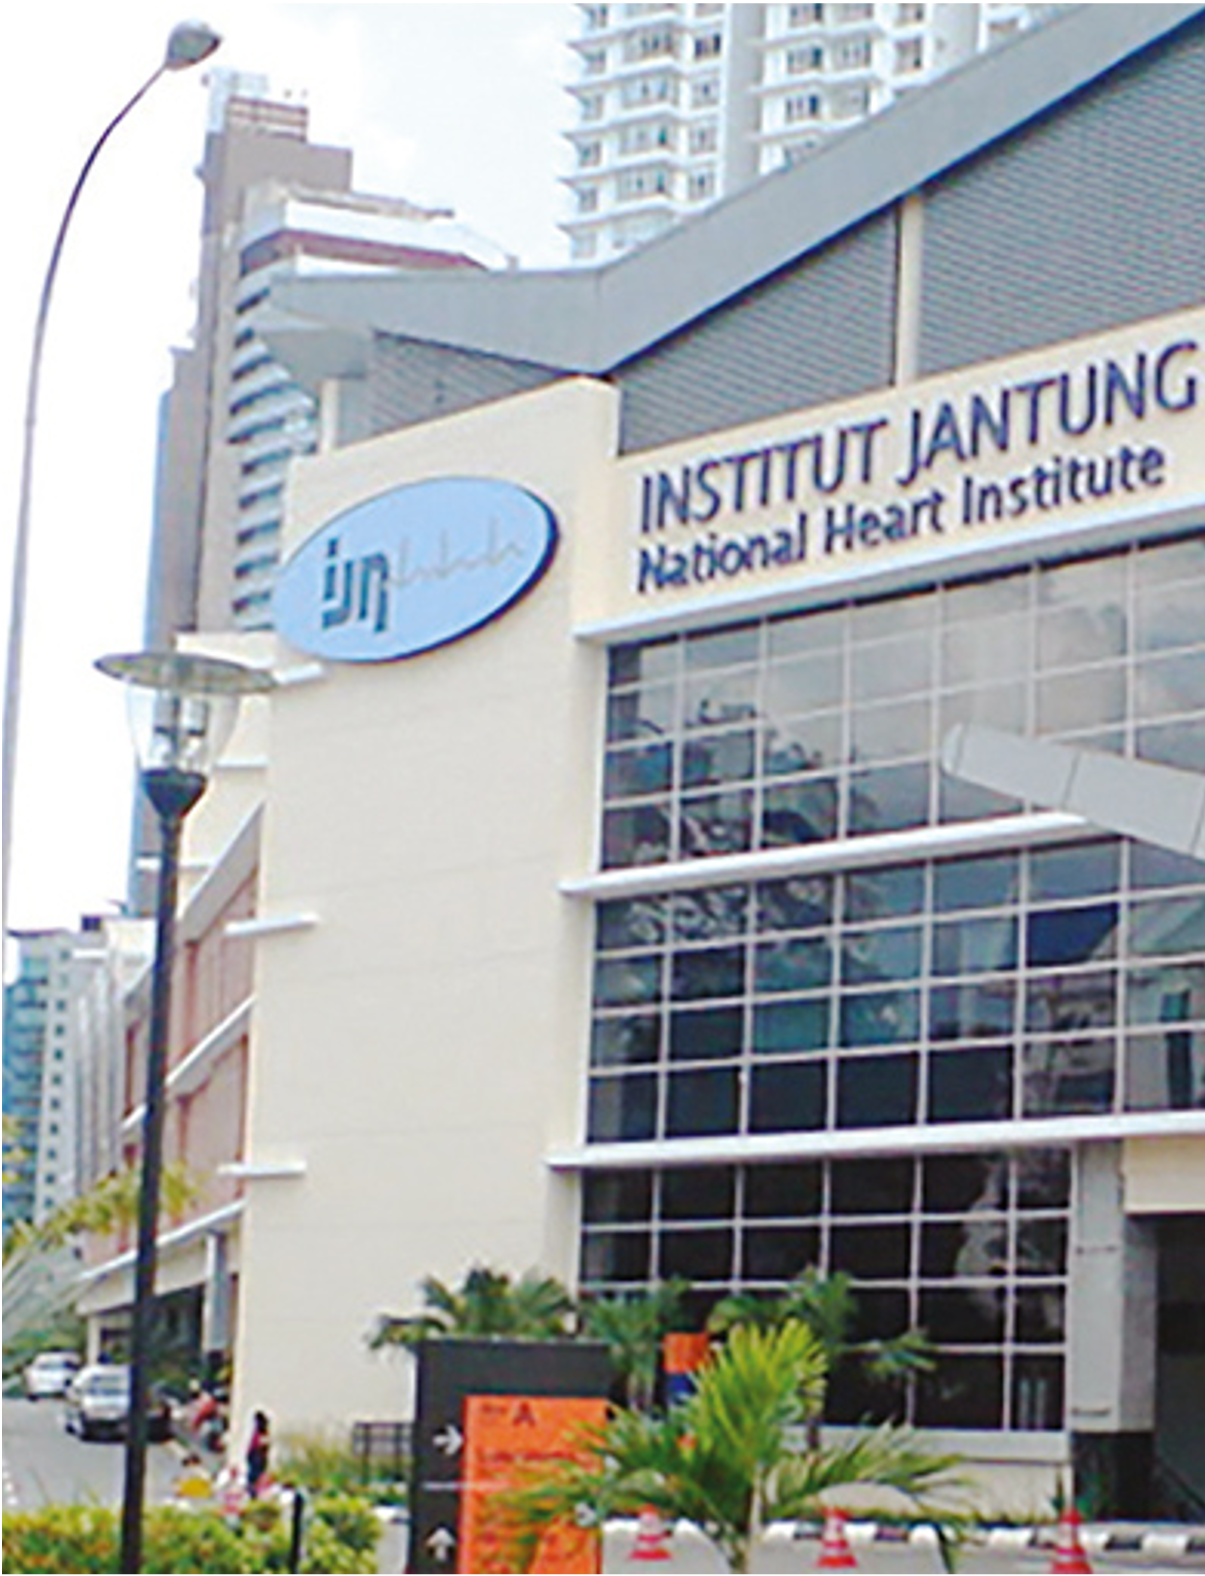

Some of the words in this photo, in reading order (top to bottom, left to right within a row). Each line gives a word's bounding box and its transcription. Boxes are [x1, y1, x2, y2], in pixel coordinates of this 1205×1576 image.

[640, 416, 888, 534] INSTITUT
[896, 339, 1198, 488] JANTUNG
[637, 512, 807, 593] National
[824, 487, 946, 555] Heart
[961, 443, 1166, 526] Institute
[512, 1401, 536, 1428] A
